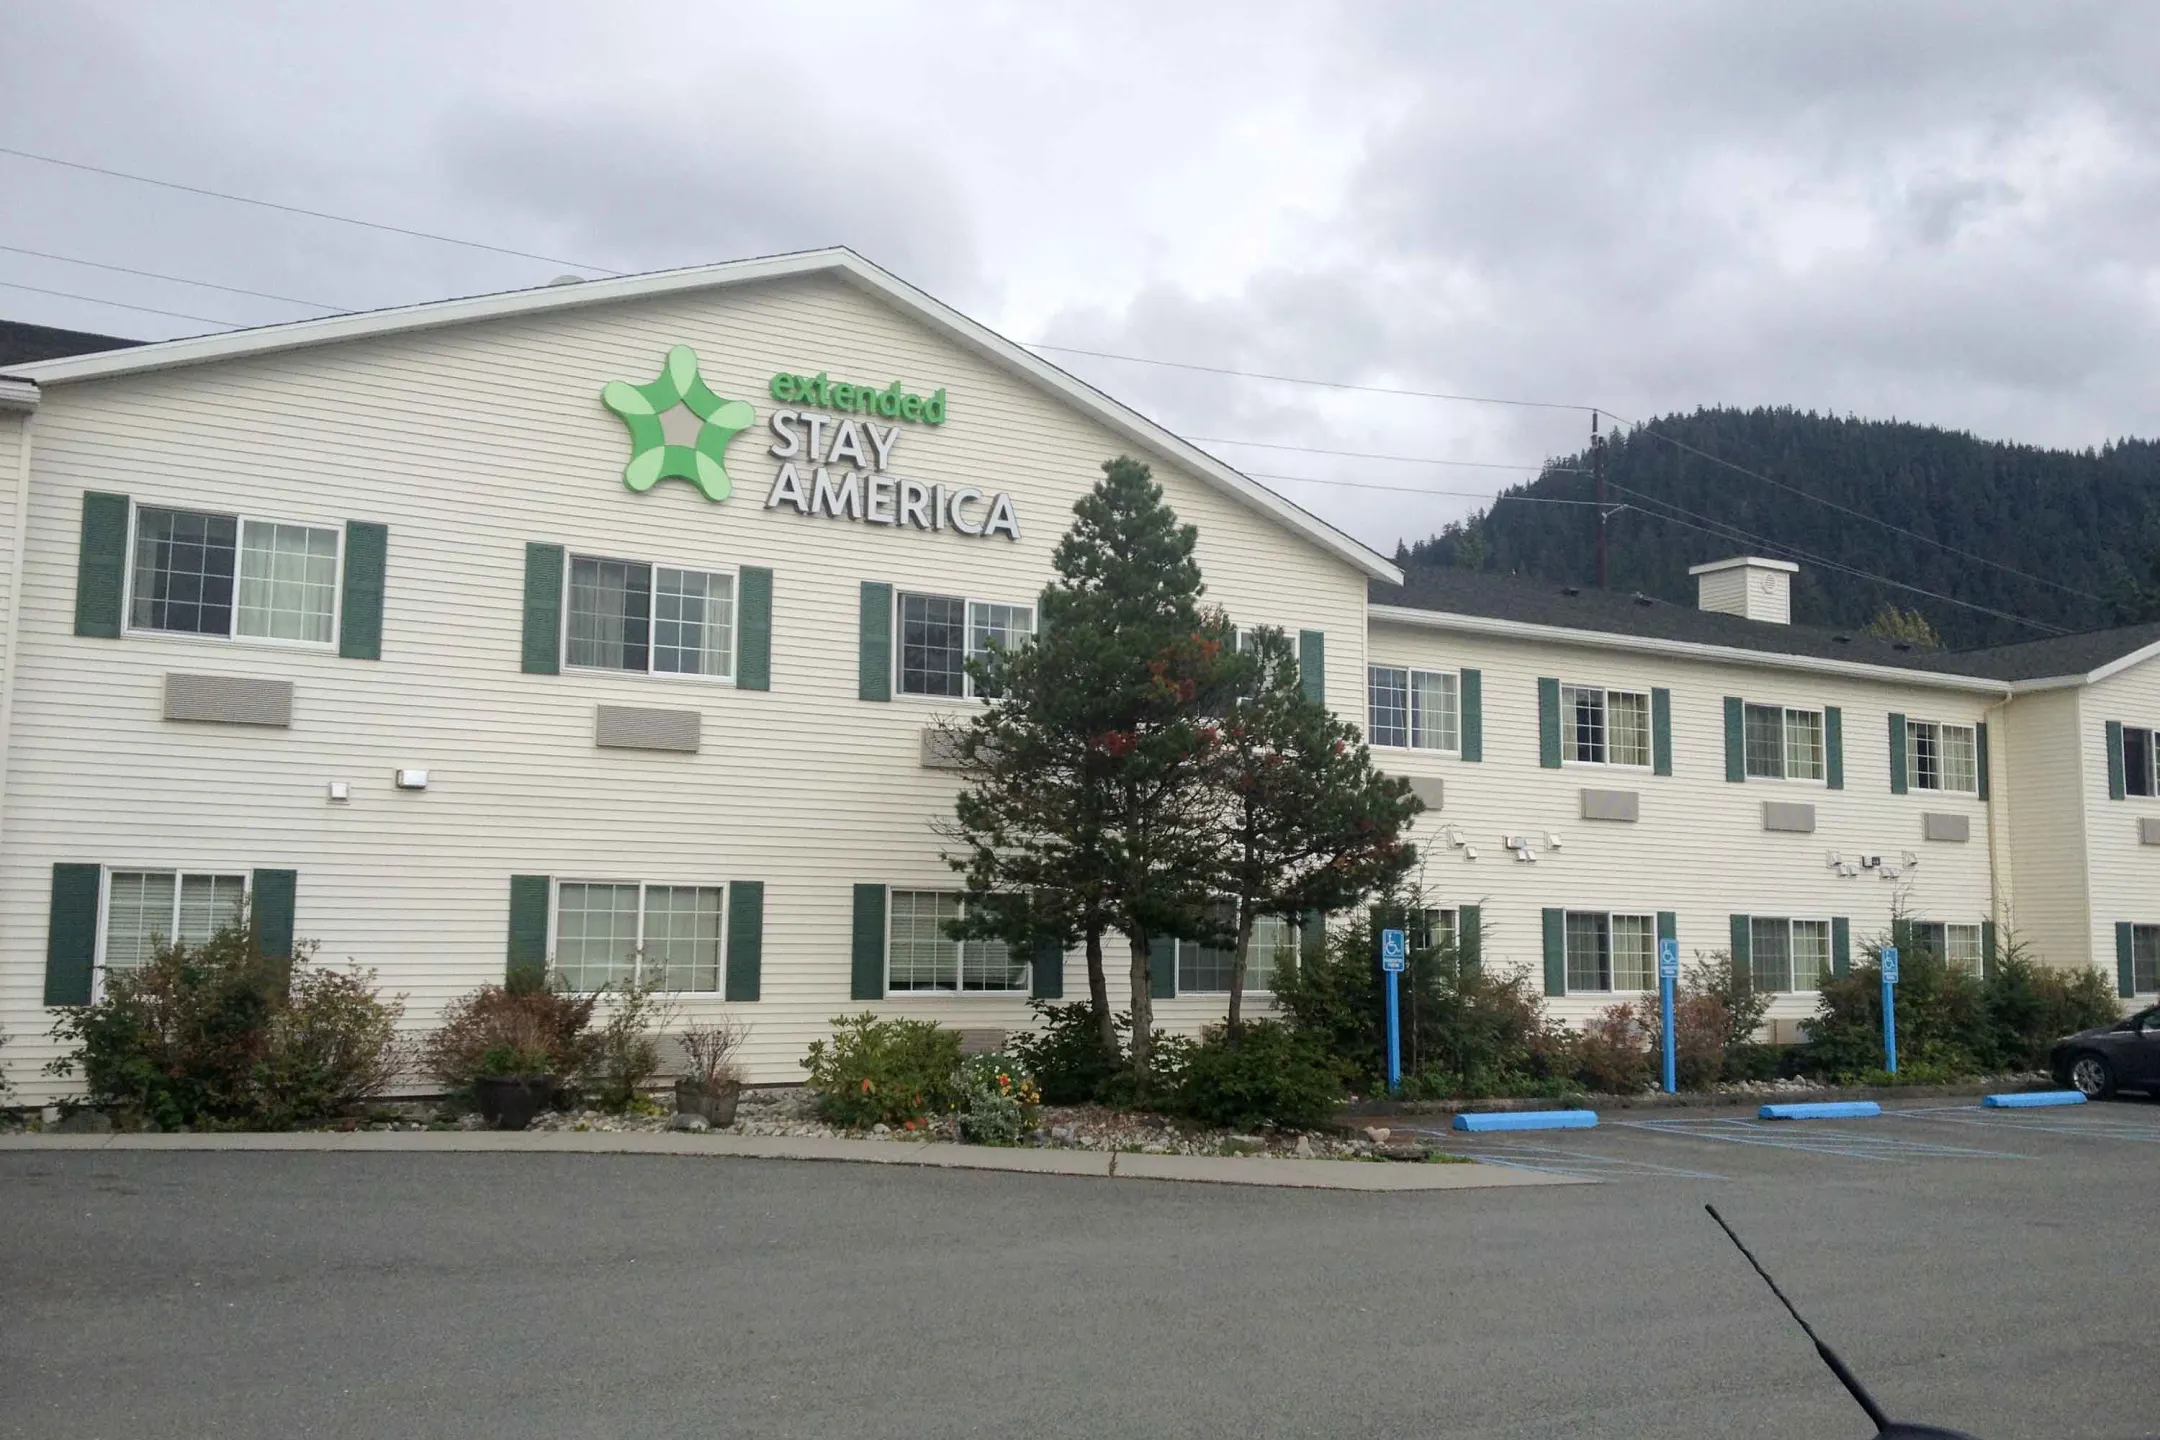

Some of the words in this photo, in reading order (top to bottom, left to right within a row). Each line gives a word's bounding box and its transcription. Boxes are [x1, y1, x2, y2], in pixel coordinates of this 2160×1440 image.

[768, 371, 946, 426] extended
[768, 409, 900, 471] STAY
[764, 462, 1022, 540] AMERICA
